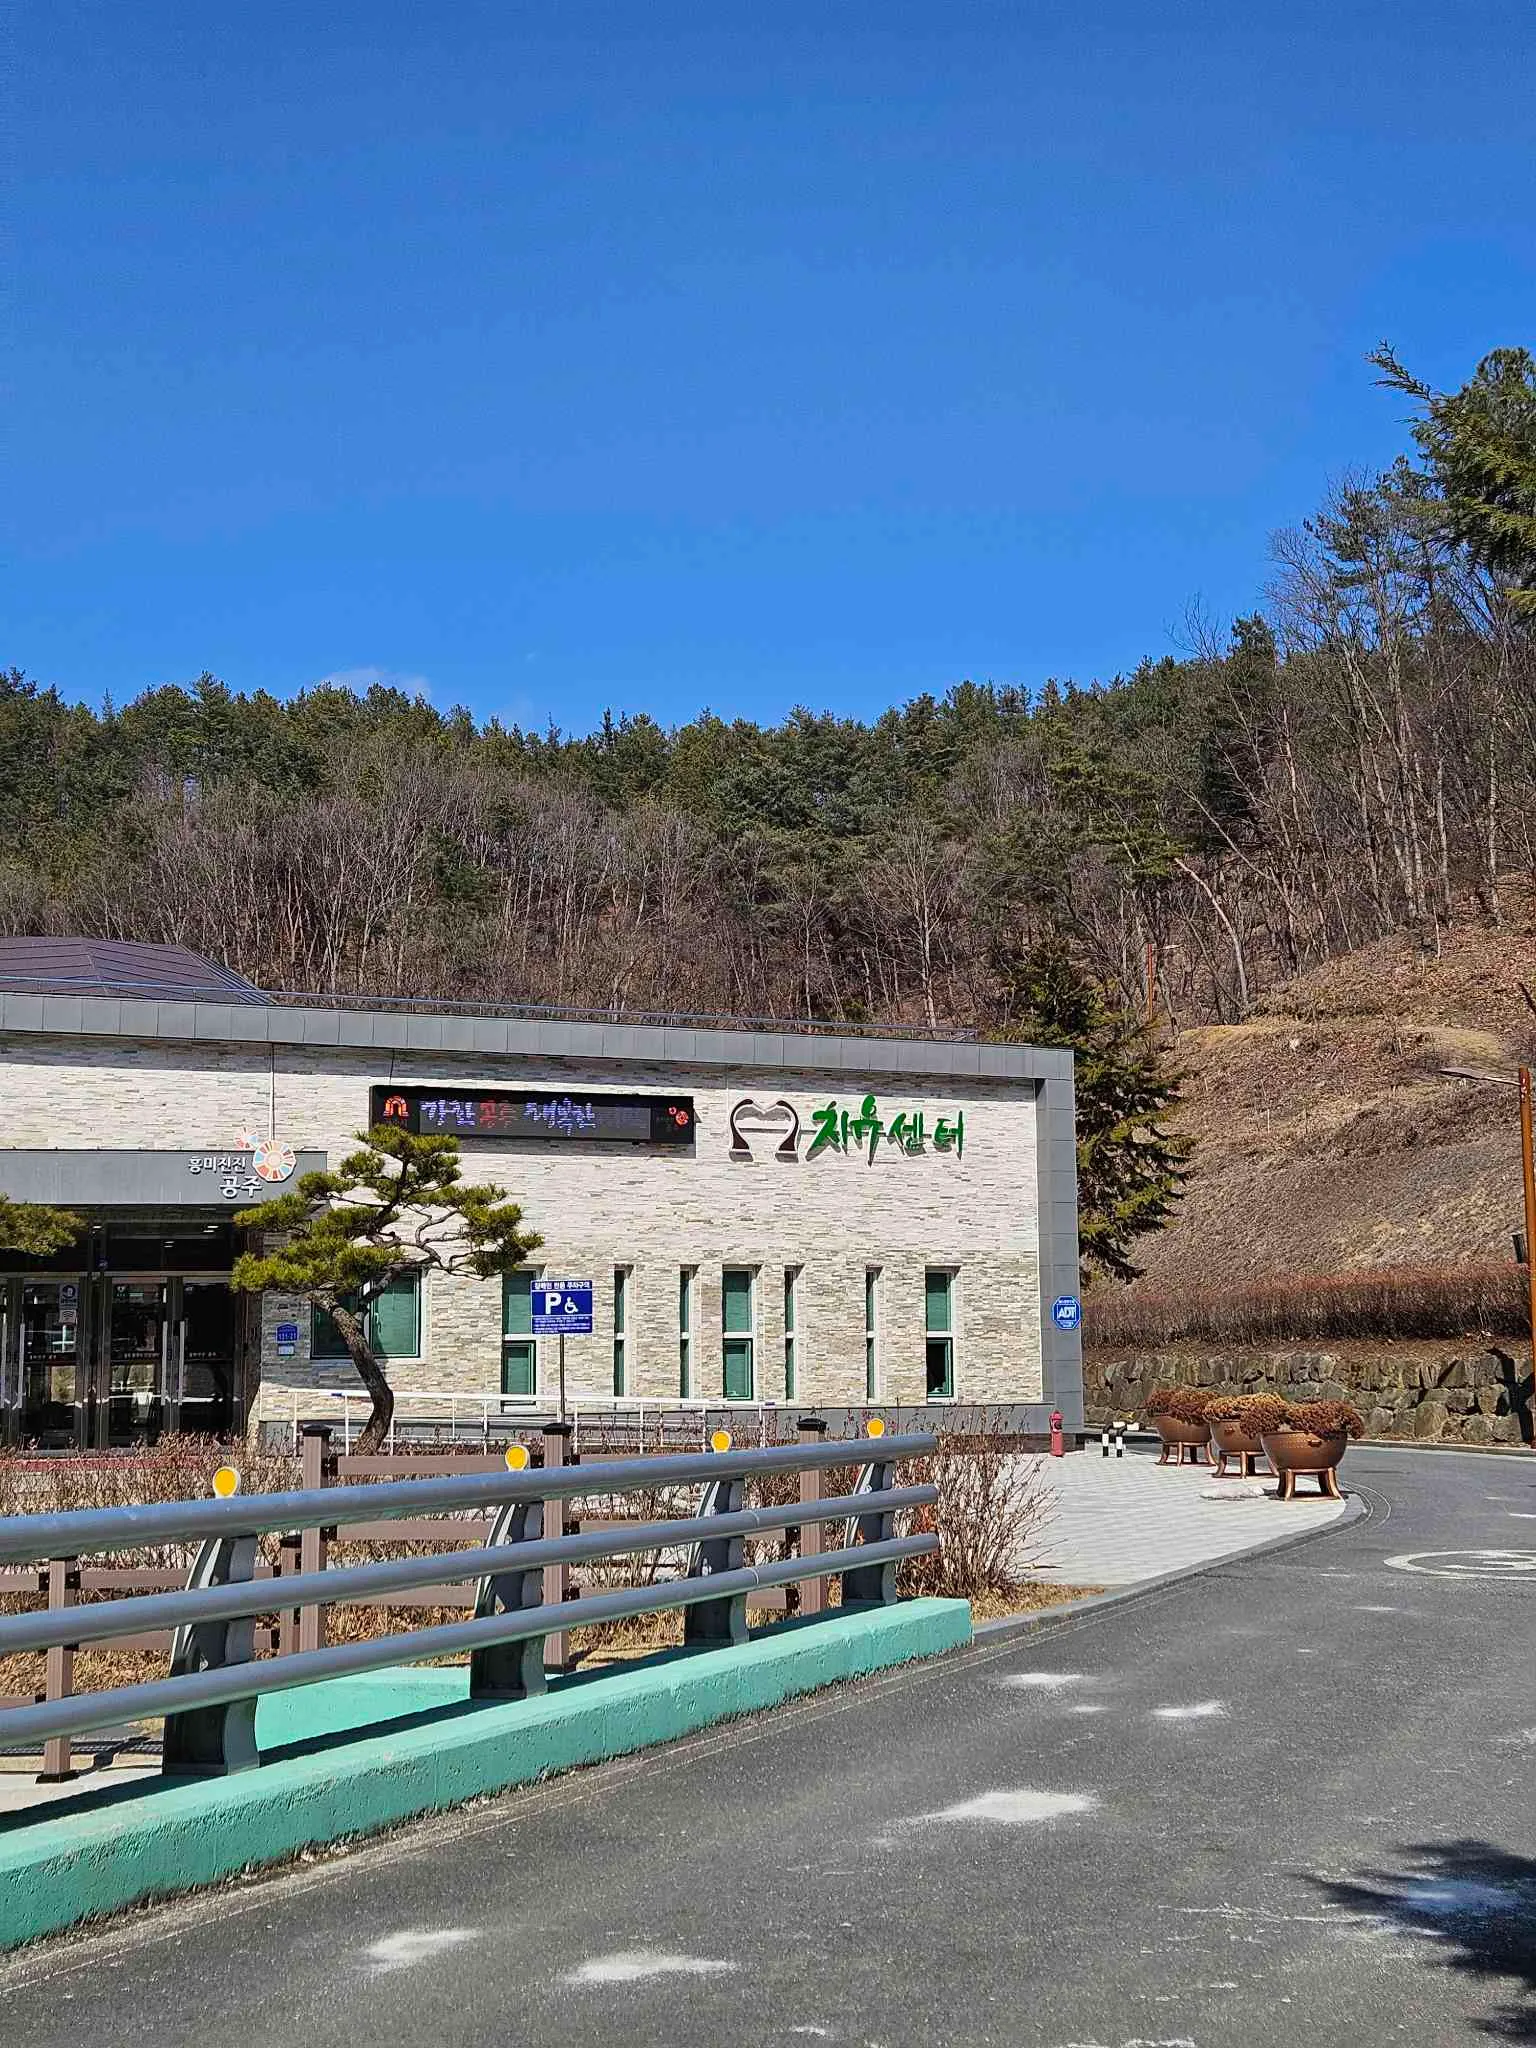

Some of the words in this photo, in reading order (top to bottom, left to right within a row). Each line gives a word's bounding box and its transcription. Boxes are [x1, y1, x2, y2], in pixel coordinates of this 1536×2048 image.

[808, 1095, 963, 1163] 치유센터
[188, 1156, 247, 1174] 흥미진진
[220, 1175, 263, 1198] 공주
[545, 1292, 562, 1315] P
[1058, 1306, 1075, 1319] ADT
